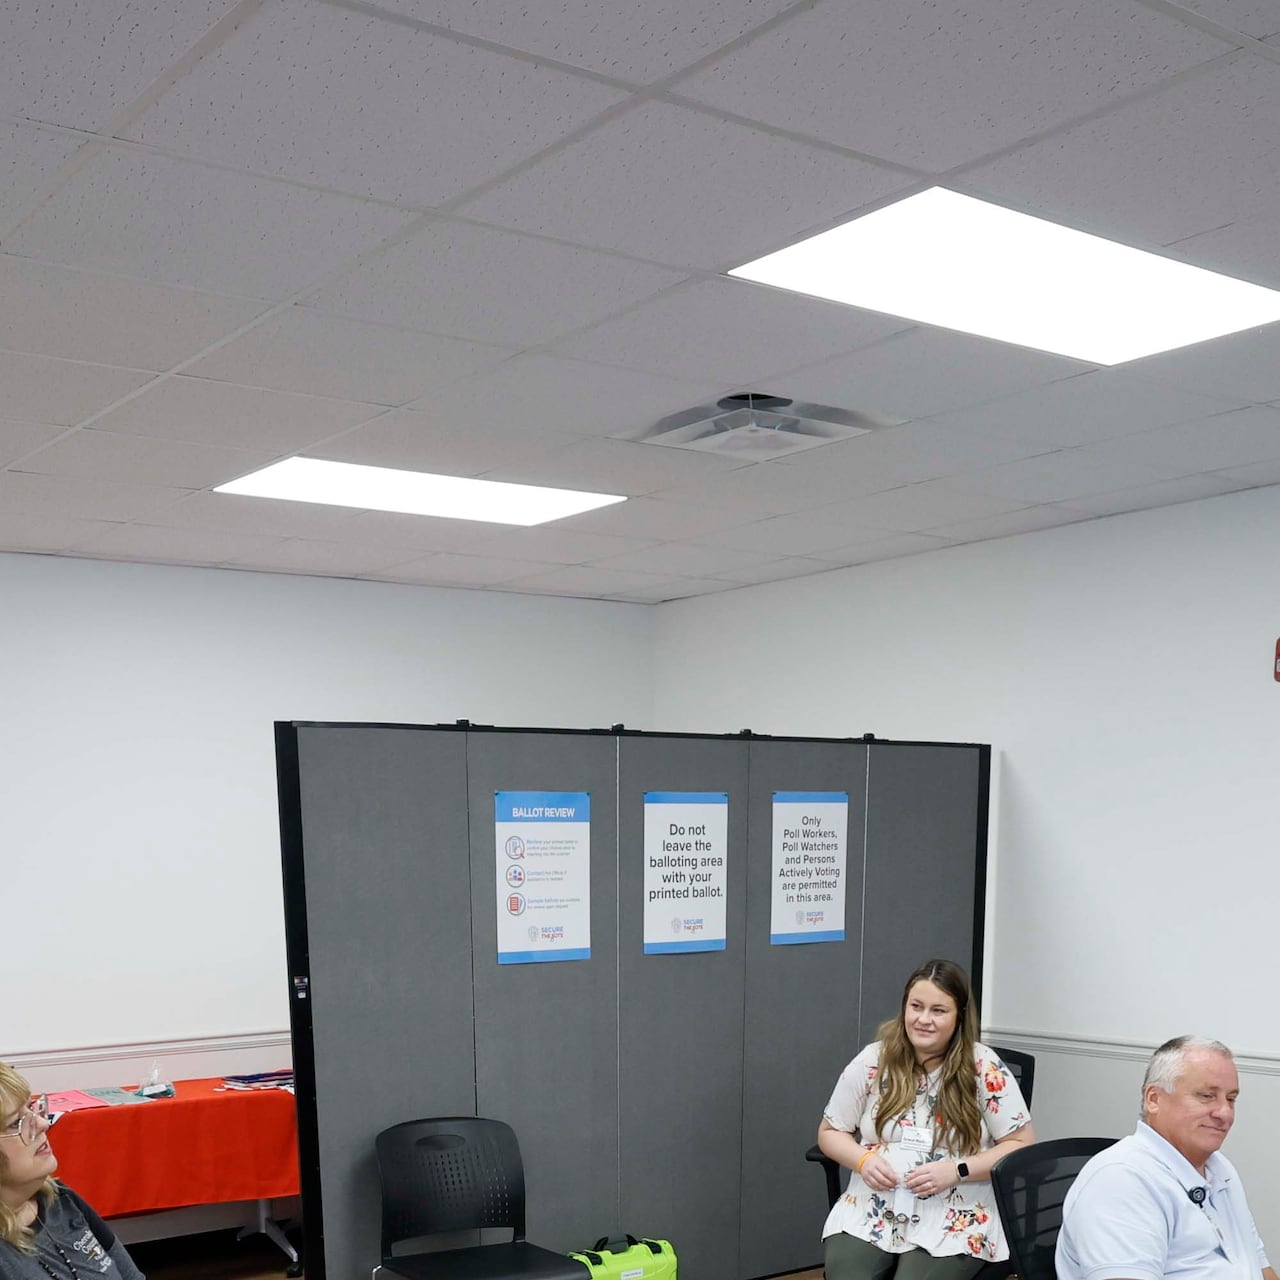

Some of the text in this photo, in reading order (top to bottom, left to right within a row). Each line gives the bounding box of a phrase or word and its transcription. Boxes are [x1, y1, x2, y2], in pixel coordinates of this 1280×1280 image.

[512, 807, 575, 818] BALLOT REVIEW
[801, 815, 822, 828] Only
[669, 823, 706, 836] Do not
[783, 829, 838, 839] Poll Workers,
[662, 839, 712, 852] leave the
[782, 842, 838, 852] Poll Watchers
[649, 855, 723, 870] balloting area
[785, 854, 836, 865] and Persons
[662, 871, 712, 886] with your
[779, 866, 840, 879] Actively Voting
[782, 879, 837, 892] are permitted
[649, 886, 723, 902] printed ballot.
[786, 893, 833, 903] in this area.
